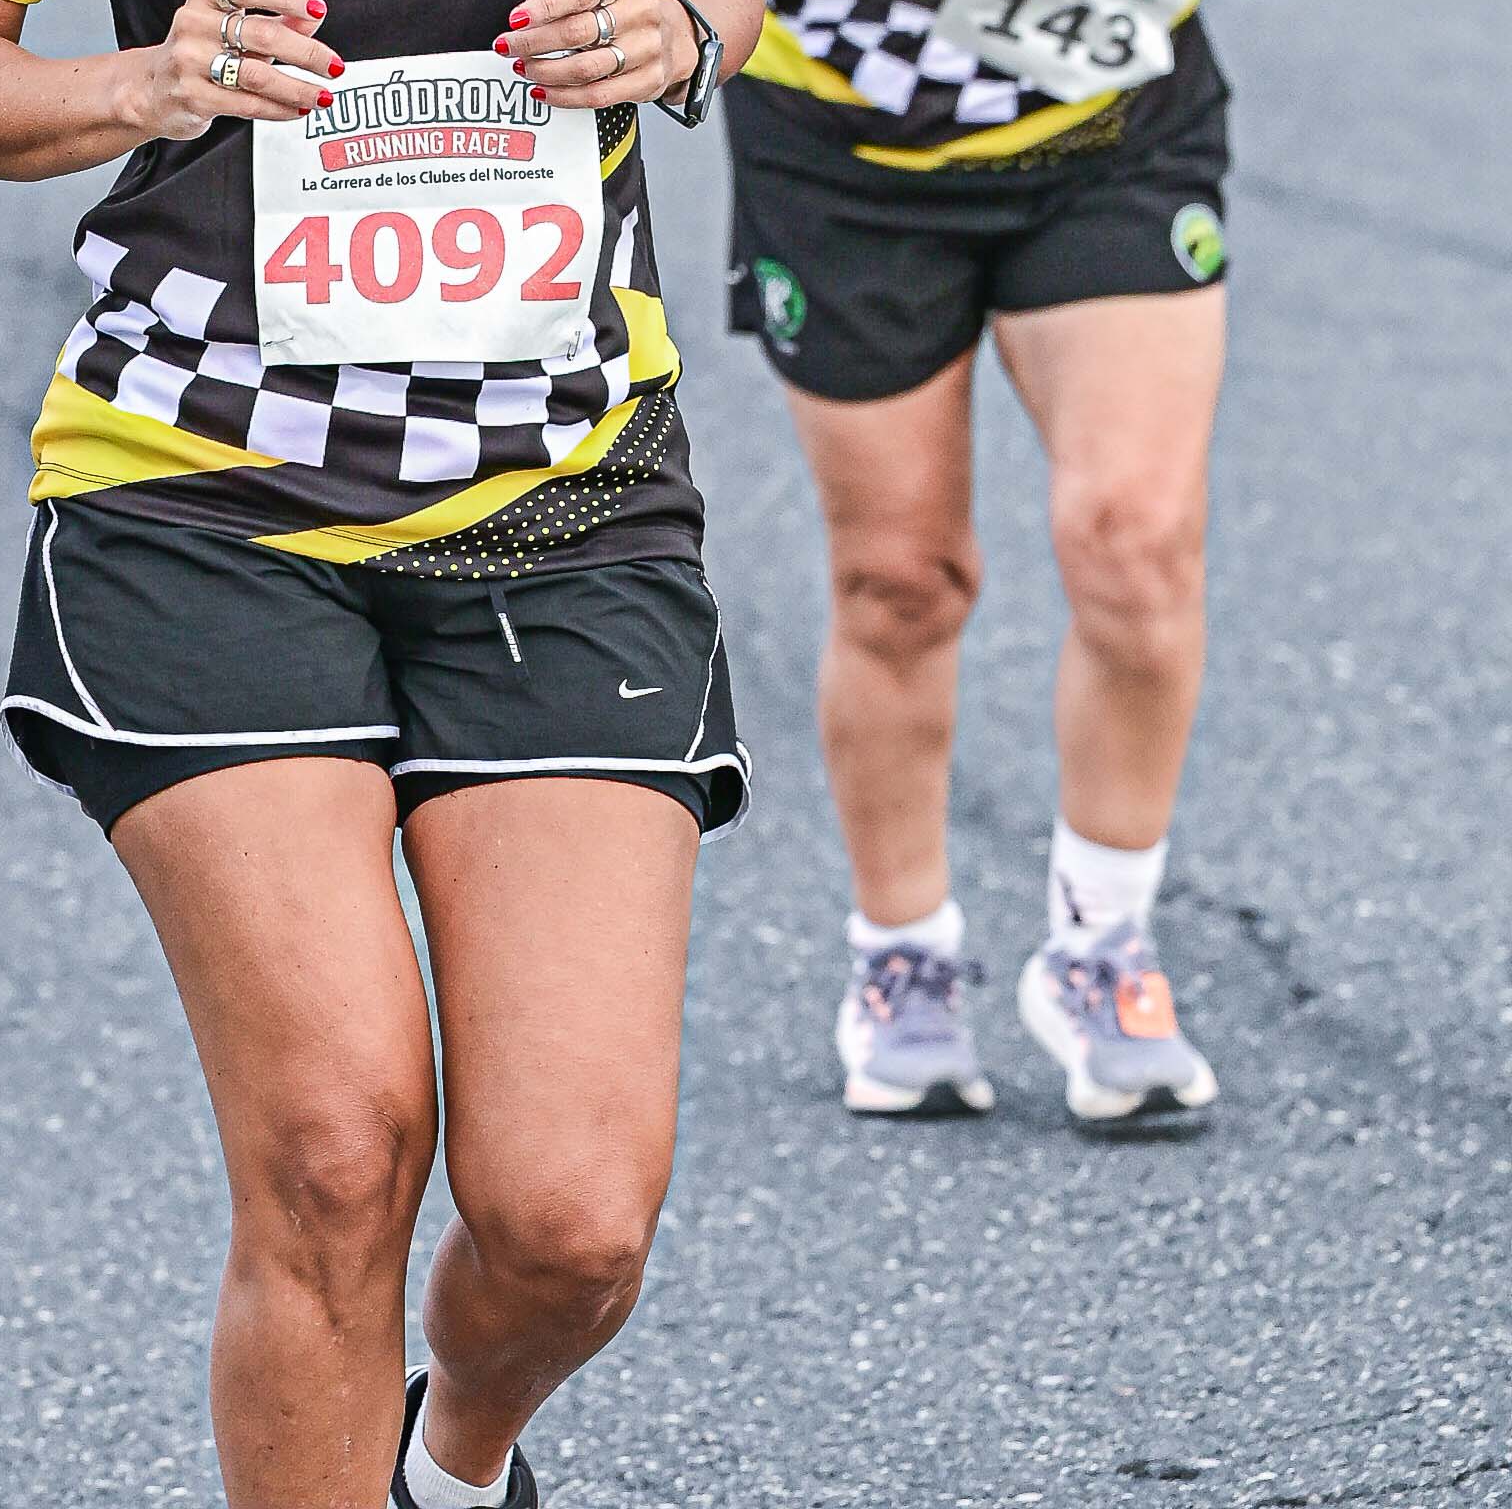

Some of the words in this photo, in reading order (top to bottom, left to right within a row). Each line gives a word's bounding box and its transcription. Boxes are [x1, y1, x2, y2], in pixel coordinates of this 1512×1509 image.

[343, 132, 444, 166] RUNNING
[451, 131, 511, 157] RACE
[302, 178, 317, 191] La
[321, 177, 372, 190] Carrera
[376, 174, 393, 187] de
[396, 172, 416, 185] los
[419, 170, 466, 184] Clubes
[469, 169, 489, 182] del
[494, 167, 554, 180] Noroeste
[264, 204, 584, 305] 4092
